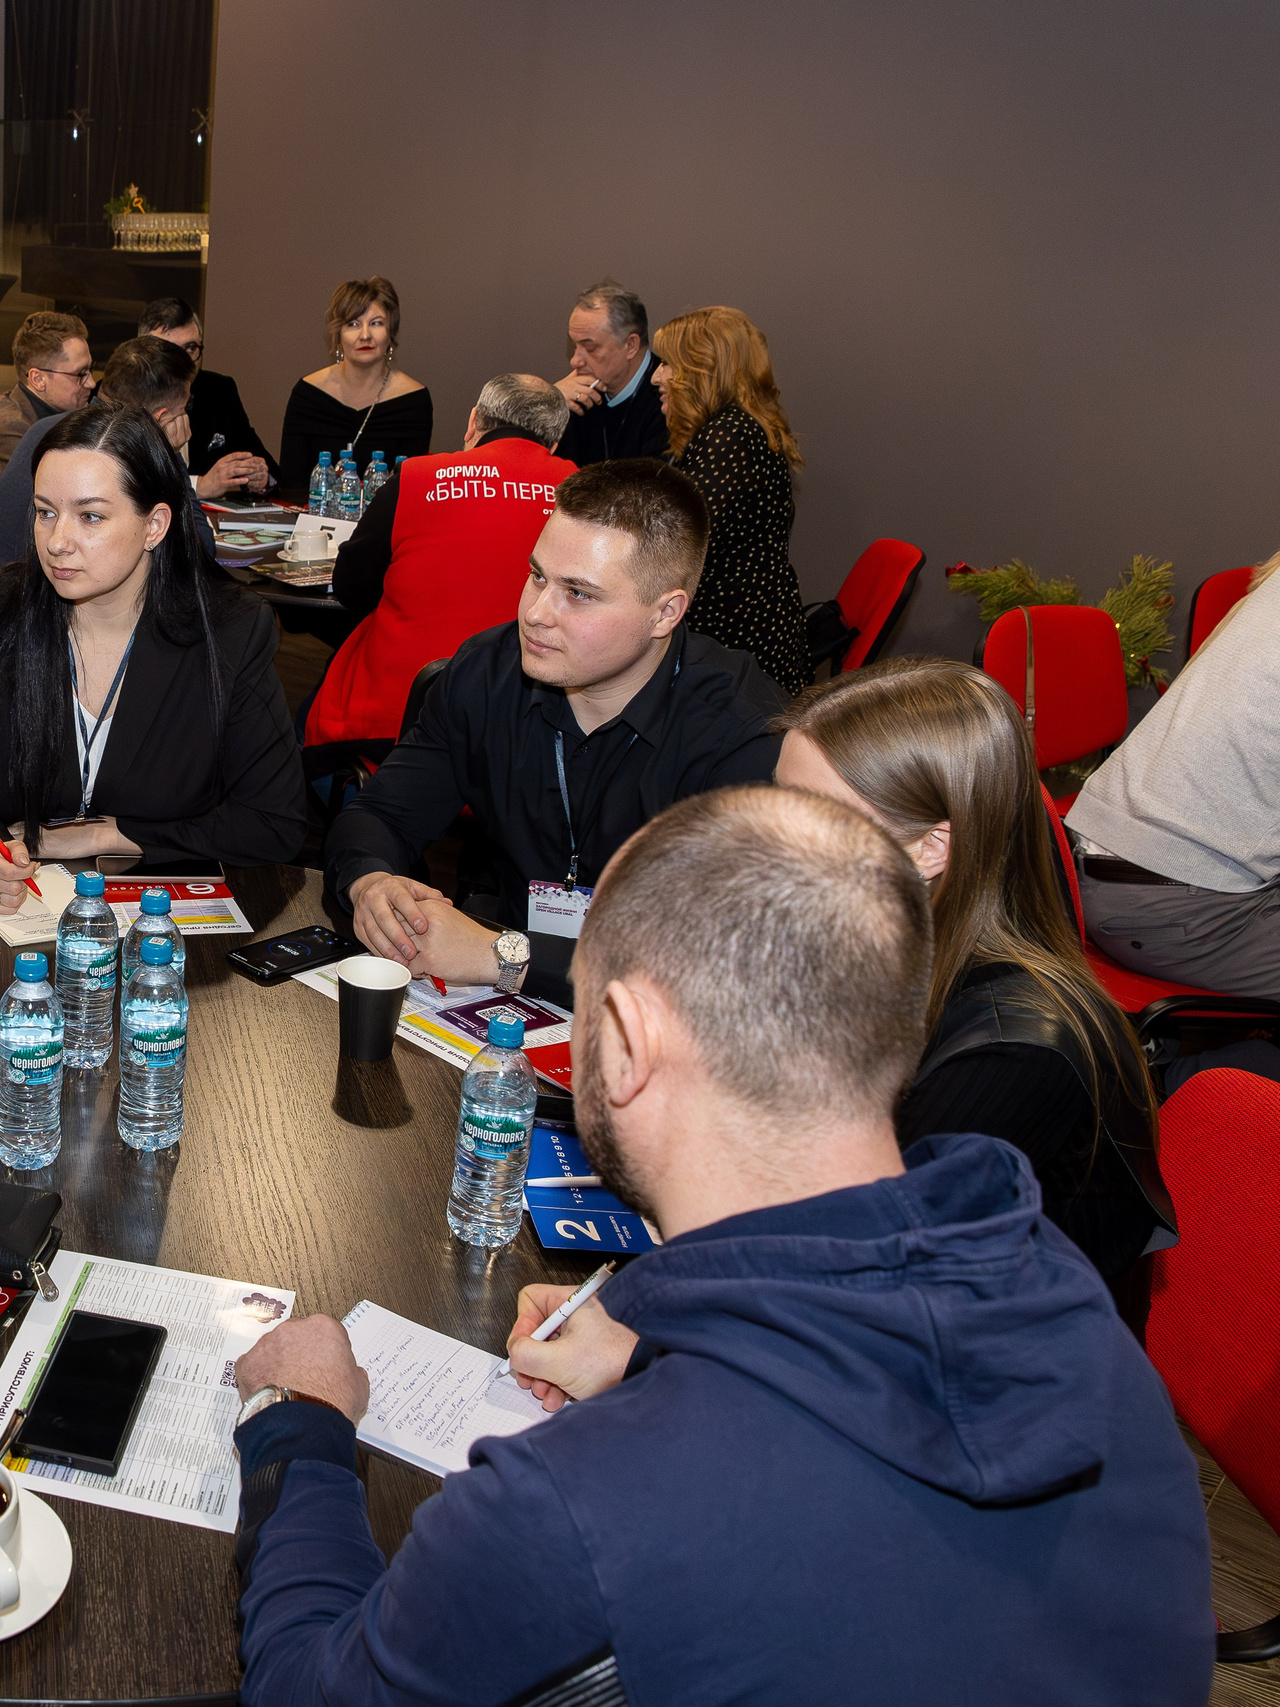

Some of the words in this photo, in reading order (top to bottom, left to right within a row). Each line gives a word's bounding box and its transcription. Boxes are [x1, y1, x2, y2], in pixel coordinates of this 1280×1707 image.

[436, 465, 500, 480] ФОРМУЛА
[426, 480, 496, 502] «БЫТЬ
[503, 482, 556, 502] ПЕРВ
[555, 1220, 602, 1241] 2
